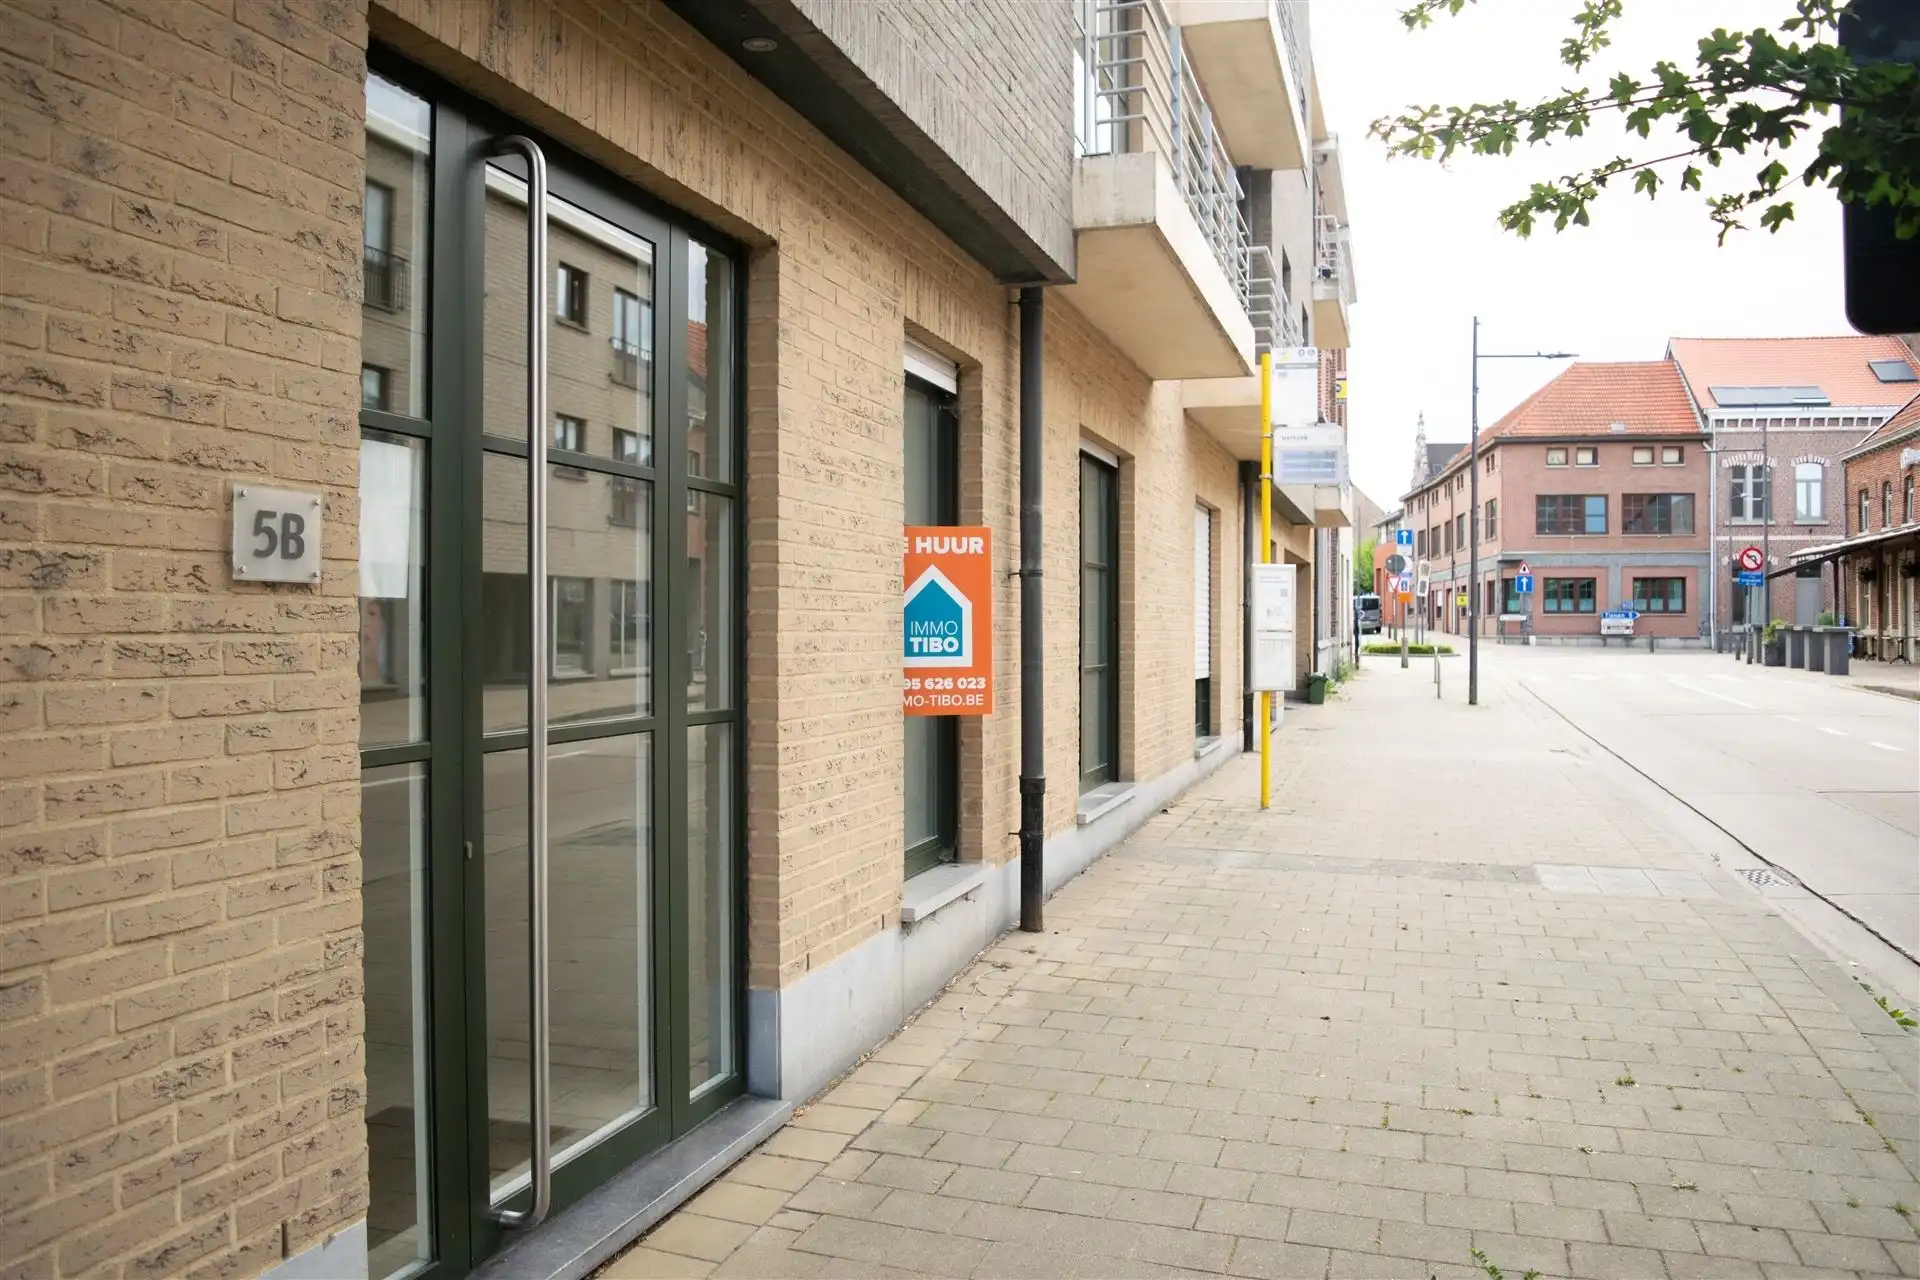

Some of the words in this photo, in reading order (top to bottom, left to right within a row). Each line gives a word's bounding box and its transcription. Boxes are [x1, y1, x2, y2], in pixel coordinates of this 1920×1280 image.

[252, 509, 305, 560] 5B
[915, 536, 984, 554] HUUR
[910, 620, 958, 636] IMMO
[909, 636, 959, 653] TIBO
[925, 677, 954, 690] 626
[957, 676, 987, 690] 023
